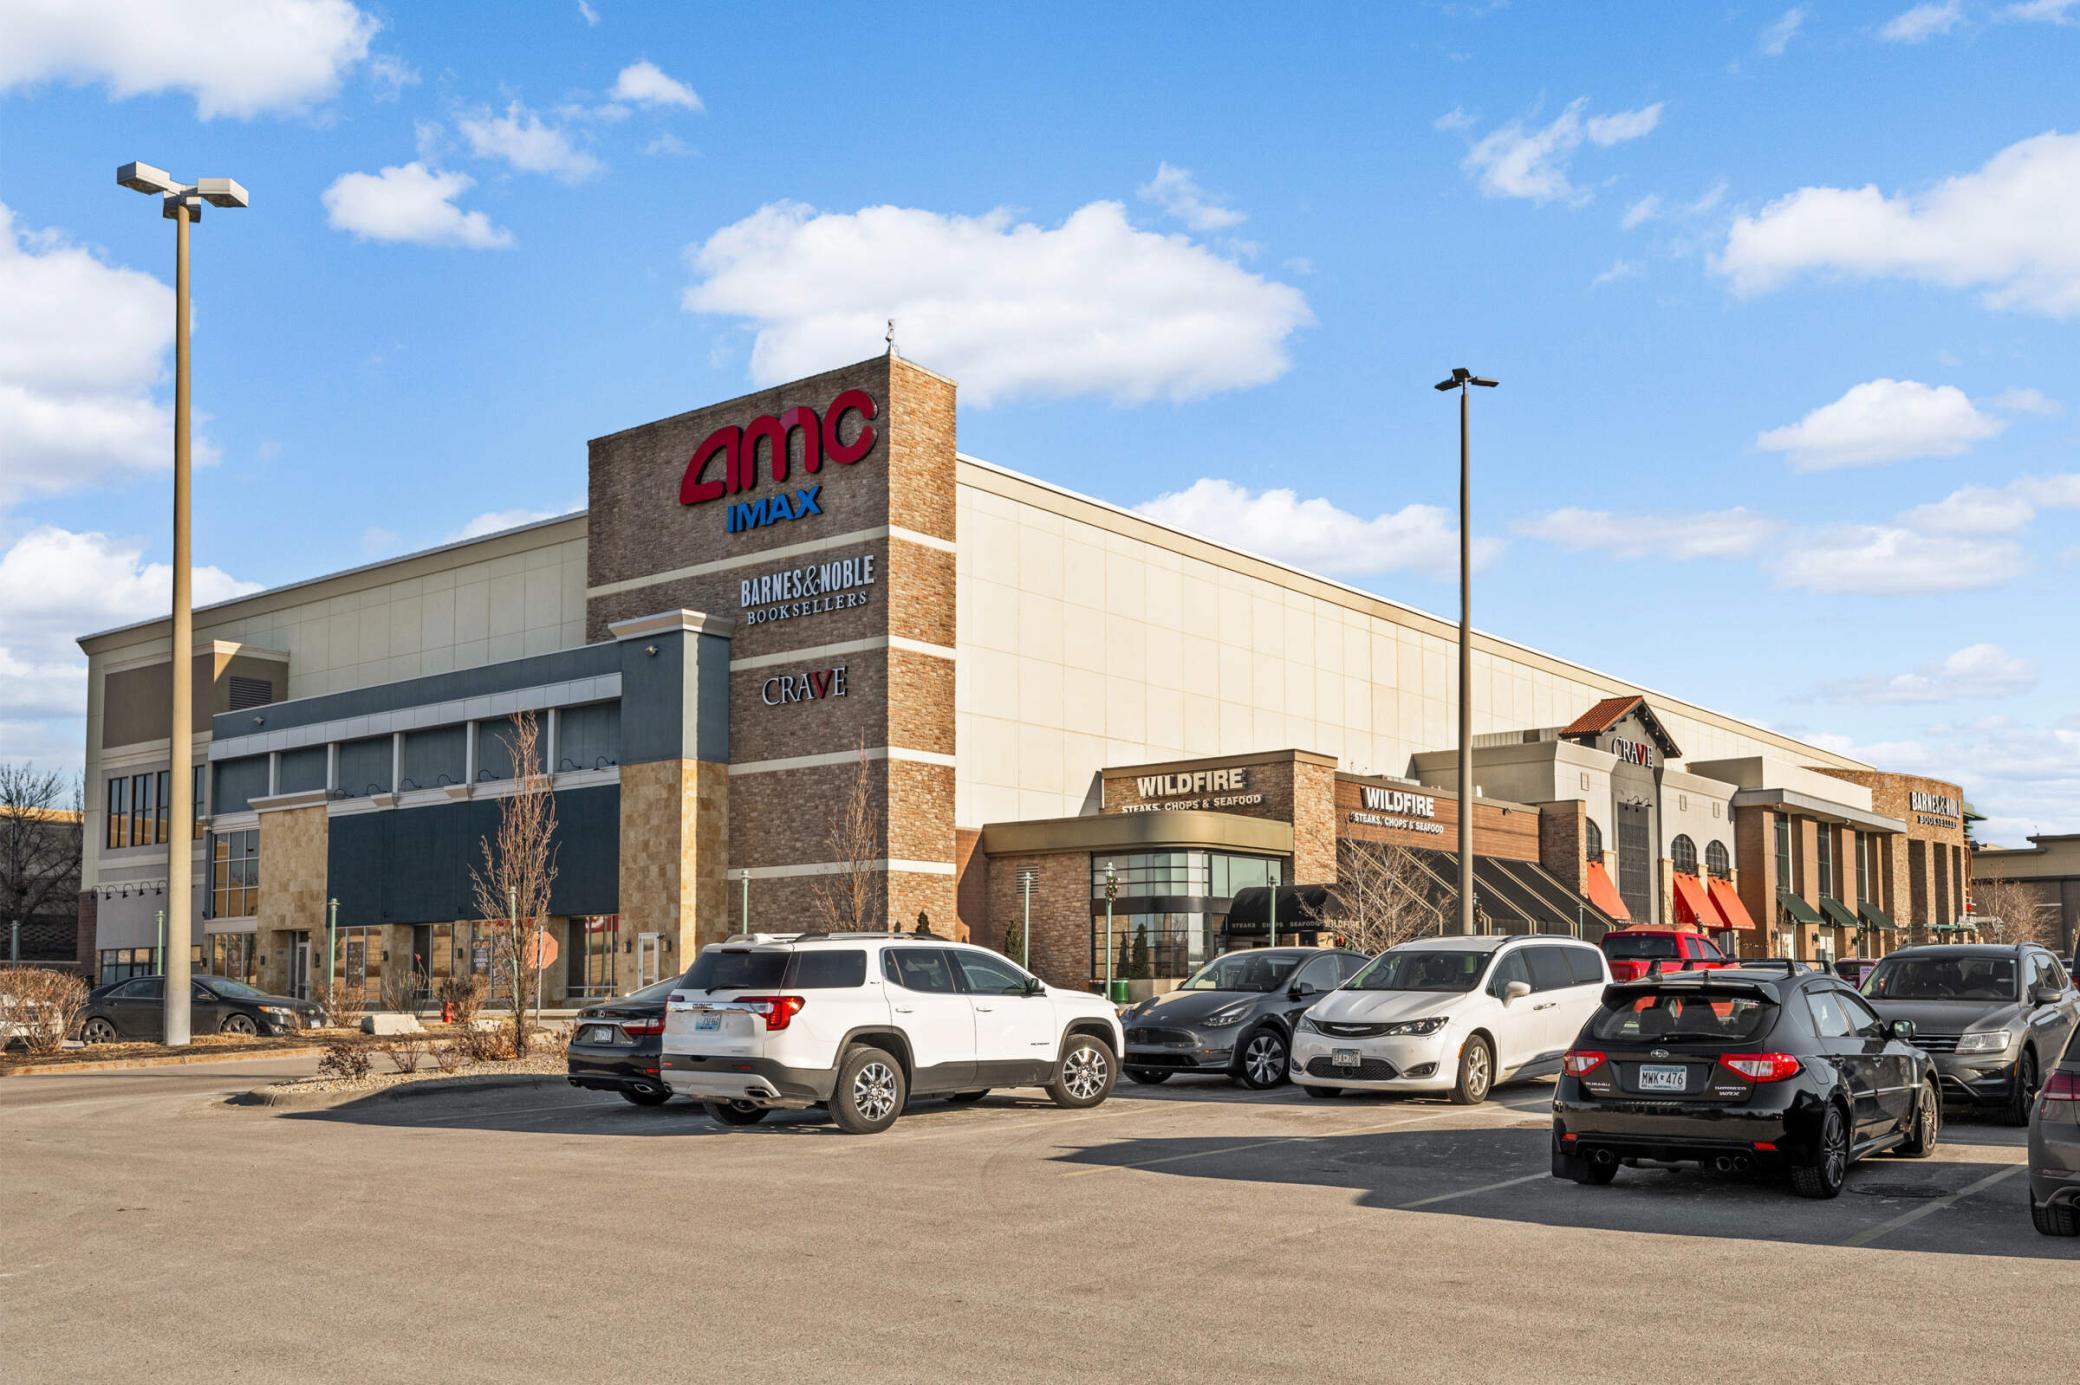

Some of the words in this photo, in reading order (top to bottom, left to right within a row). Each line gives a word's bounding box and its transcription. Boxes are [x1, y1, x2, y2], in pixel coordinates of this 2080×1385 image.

[727, 485, 822, 533] IMAX
[747, 591, 867, 625] BOOKSELLERS
[762, 665, 848, 706] CRAVE
[1613, 736, 1654, 768] CRAVE
[1137, 768, 1245, 799] WILDFIRE
[1165, 801, 1199, 812] CHOPS
[1202, 799, 1209, 808] &
[1214, 795, 1262, 807] SEAFOOD
[1364, 786, 1435, 817] WILDFIRE
[1385, 817, 1407, 828] CHOPS
[1409, 820, 1414, 829] &
[1416, 821, 1444, 833] SEAFOOD
[1641, 1072, 1659, 1085] MWK
[1666, 1072, 1683, 1086] 476
